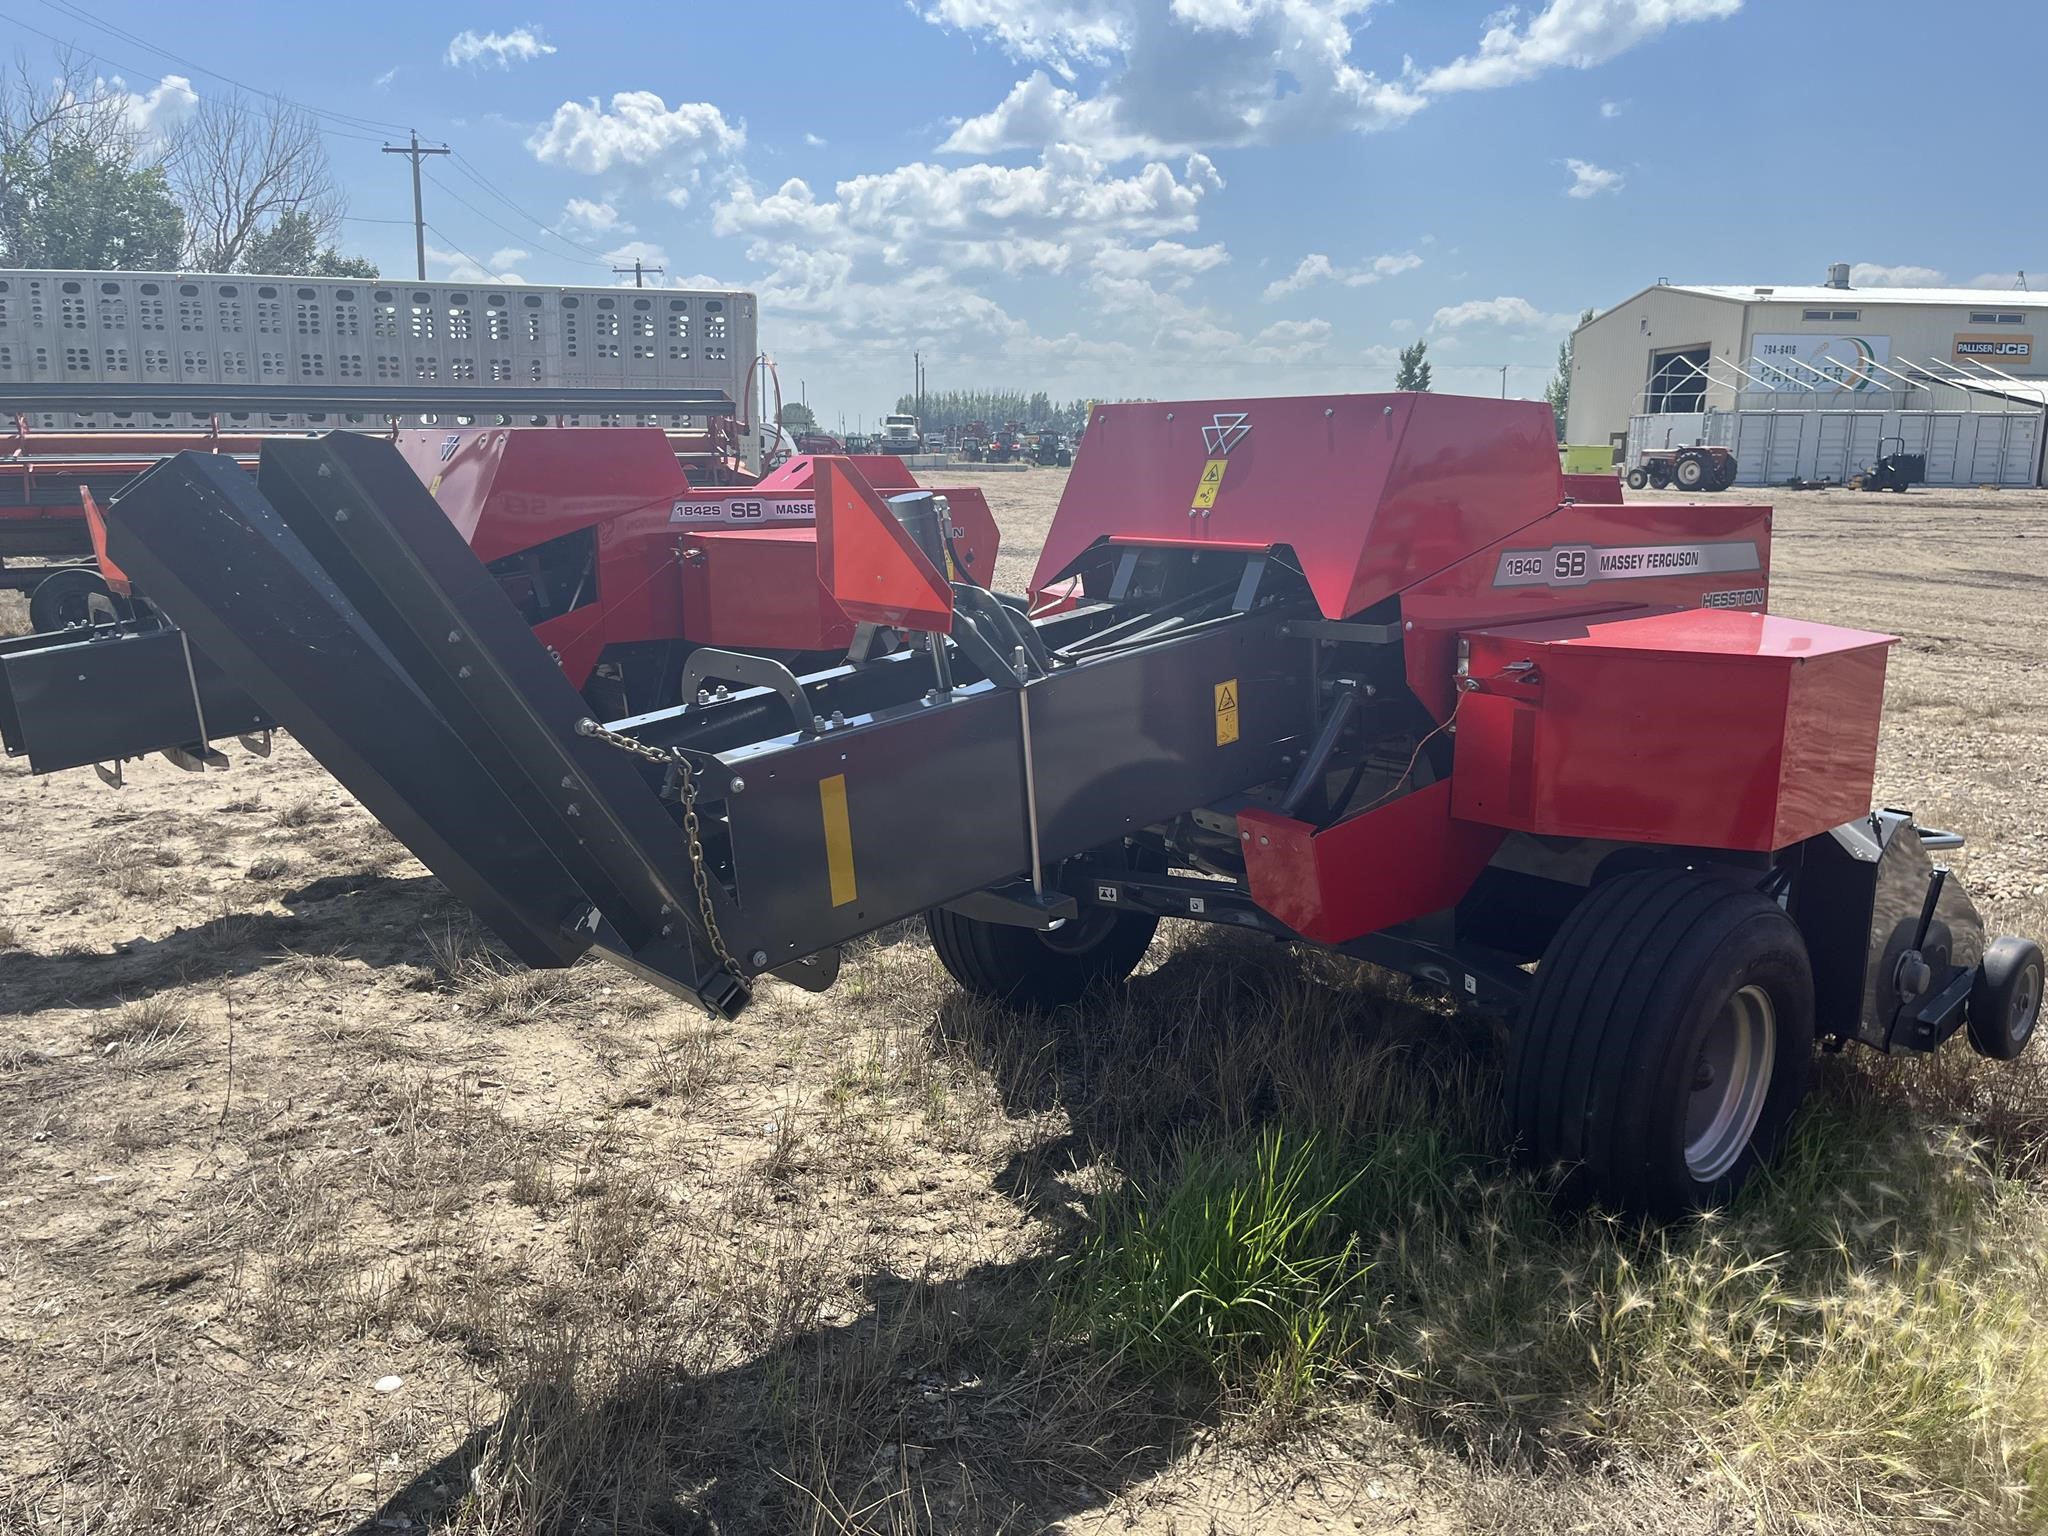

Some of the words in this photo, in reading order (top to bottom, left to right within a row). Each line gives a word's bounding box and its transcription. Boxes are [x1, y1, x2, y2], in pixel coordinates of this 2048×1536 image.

[1763, 344, 1797, 355] 794-6416
[1957, 343, 1993, 353] PALLISER
[1995, 343, 2029, 355] JCB
[1760, 366, 1844, 383] PALLSER
[676, 505, 721, 516] 1842S
[730, 502, 762, 518] SB
[775, 503, 815, 514] MASSE
[1506, 558, 1542, 576] 1840
[1554, 550, 1587, 579] SB
[1599, 554, 1645, 571] MASSEY
[1646, 551, 1699, 569] FERGUSON
[1702, 588, 1765, 608] HESSTON
